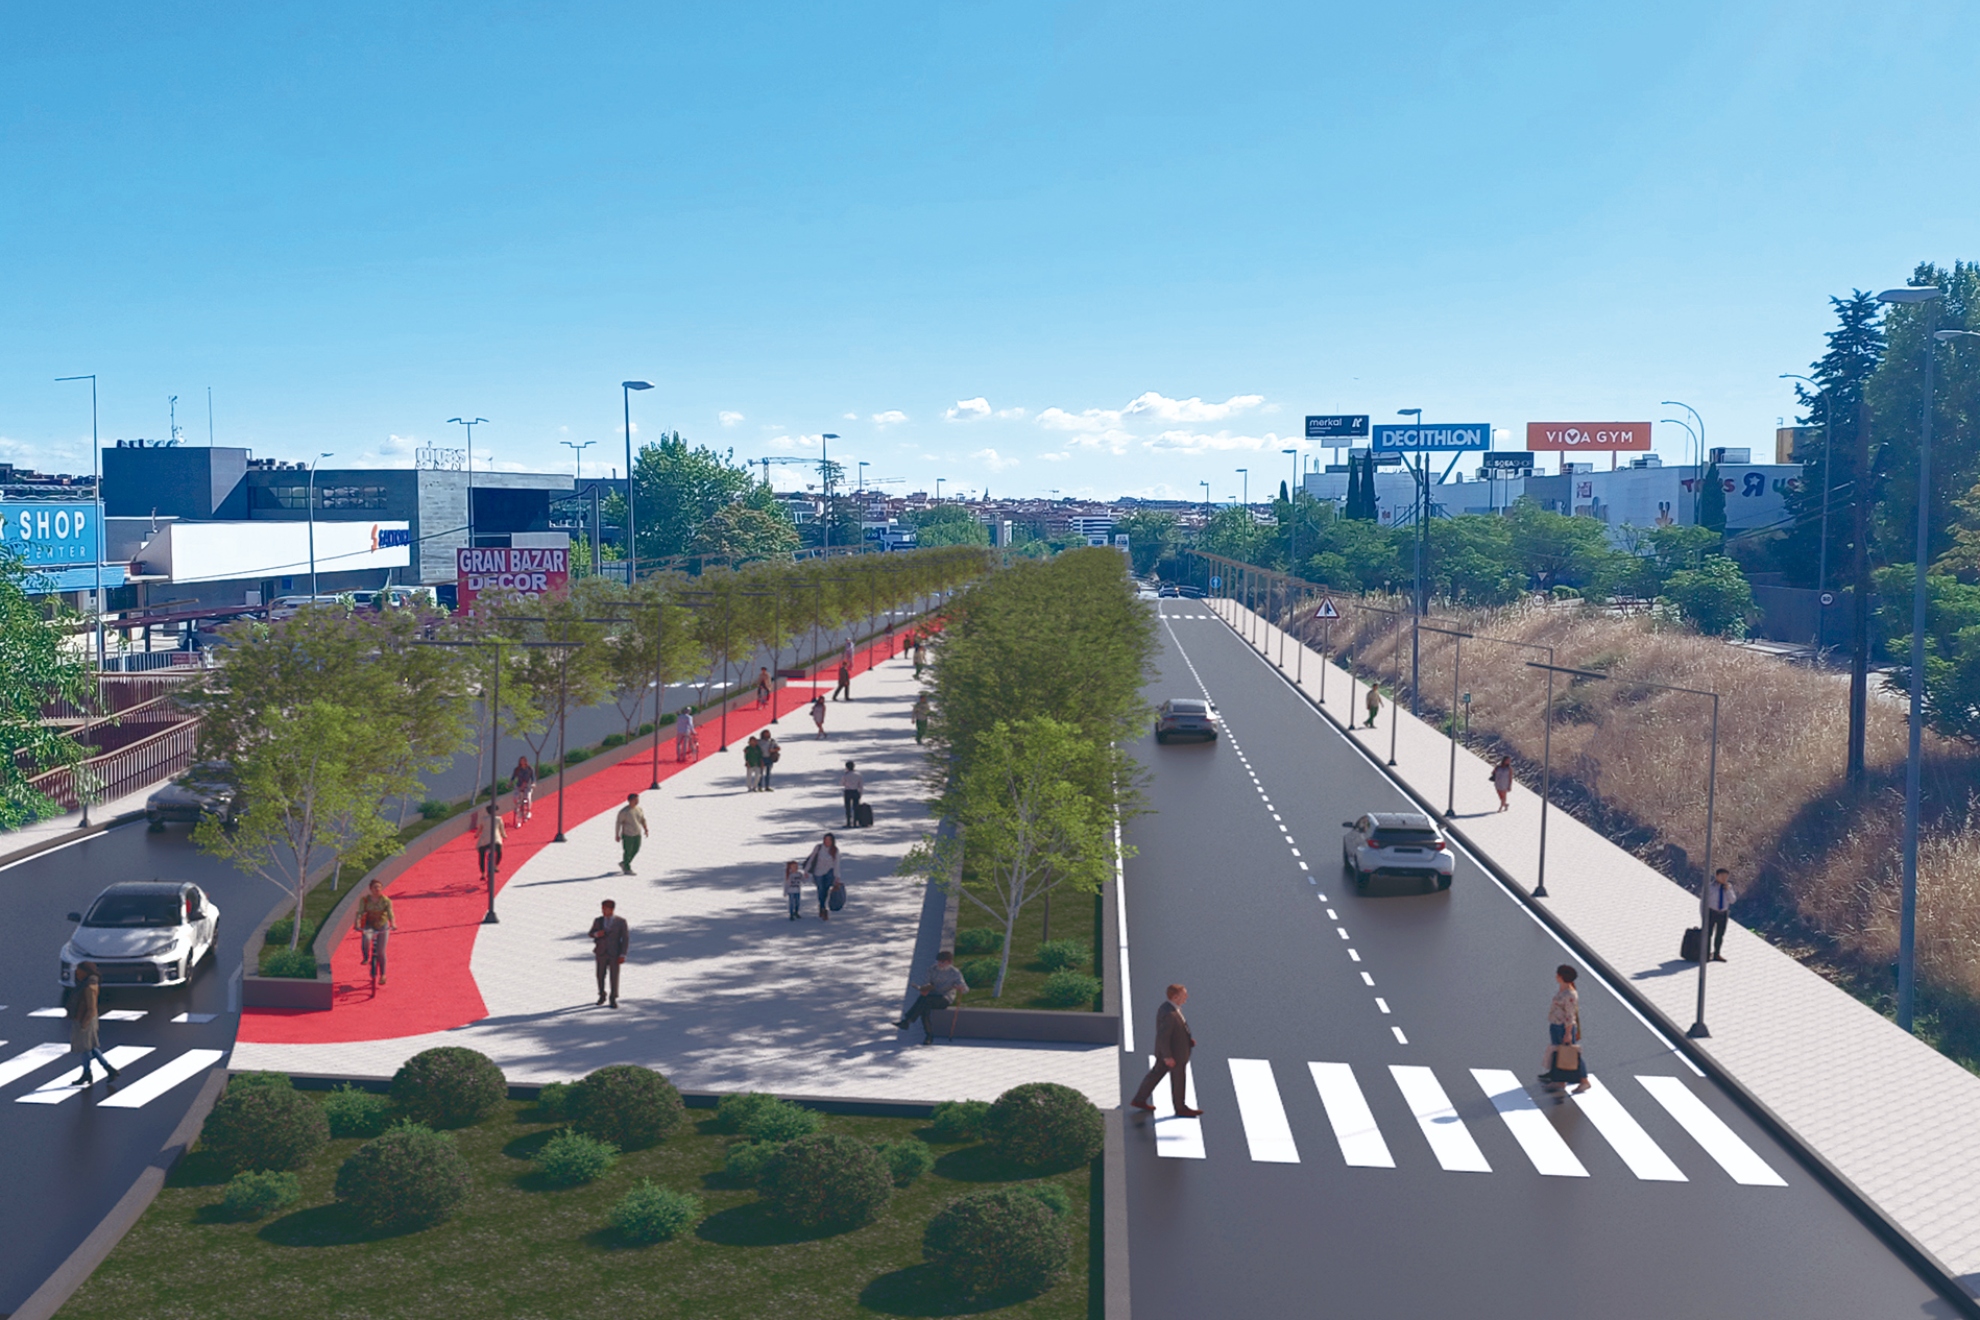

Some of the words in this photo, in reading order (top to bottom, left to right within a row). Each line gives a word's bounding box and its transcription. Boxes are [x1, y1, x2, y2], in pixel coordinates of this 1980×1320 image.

[1309, 418, 1342, 426] merkal
[1596, 431, 1633, 443] GYM
[20, 510, 85, 540] SHOP
[460, 549, 506, 572] GRAN
[510, 550, 565, 572] BAZAR
[468, 573, 548, 591] DECOR
